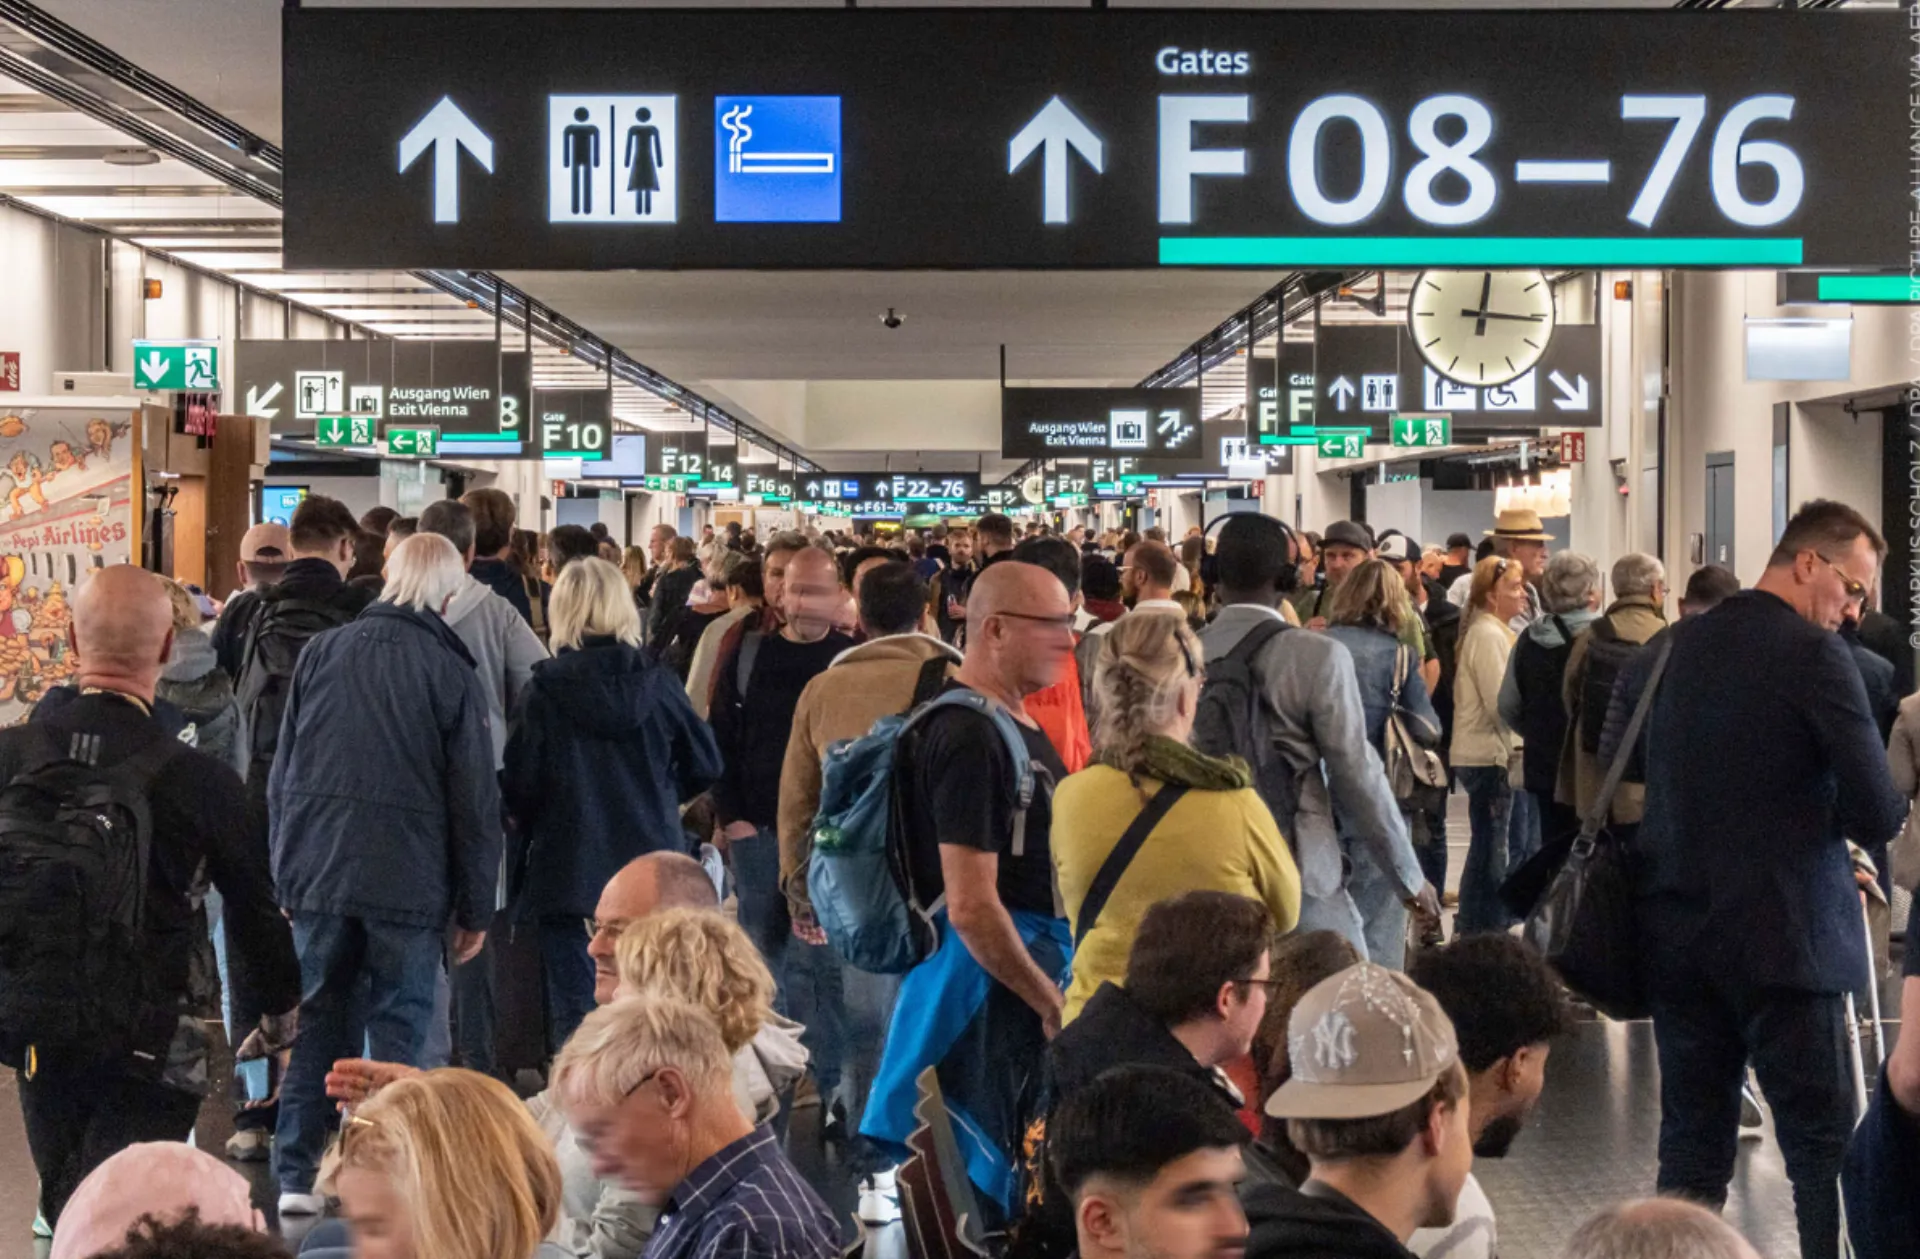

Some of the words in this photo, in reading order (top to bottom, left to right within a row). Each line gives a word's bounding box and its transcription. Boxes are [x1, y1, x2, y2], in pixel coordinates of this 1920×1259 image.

[1156, 47, 1250, 76] Gates
[1158, 94, 1249, 224] F
[389, 387, 451, 403] Ausgang
[452, 386, 490, 400] Wien
[1290, 390, 1313, 422] F
[389, 403, 417, 416] Exit
[419, 403, 469, 416] Vienna
[1260, 401, 1277, 431] F
[1029, 422, 1077, 435] Ausgang
[1077, 421, 1106, 433] Wien
[1046, 435, 1067, 446] Exit
[1068, 435, 1106, 446] Vienna
[711, 466, 733, 481] 14
[12, 530, 40, 551] Pepi
[43, 521, 127, 546] Airlines
[1311, 1010, 1358, 1070] NY
